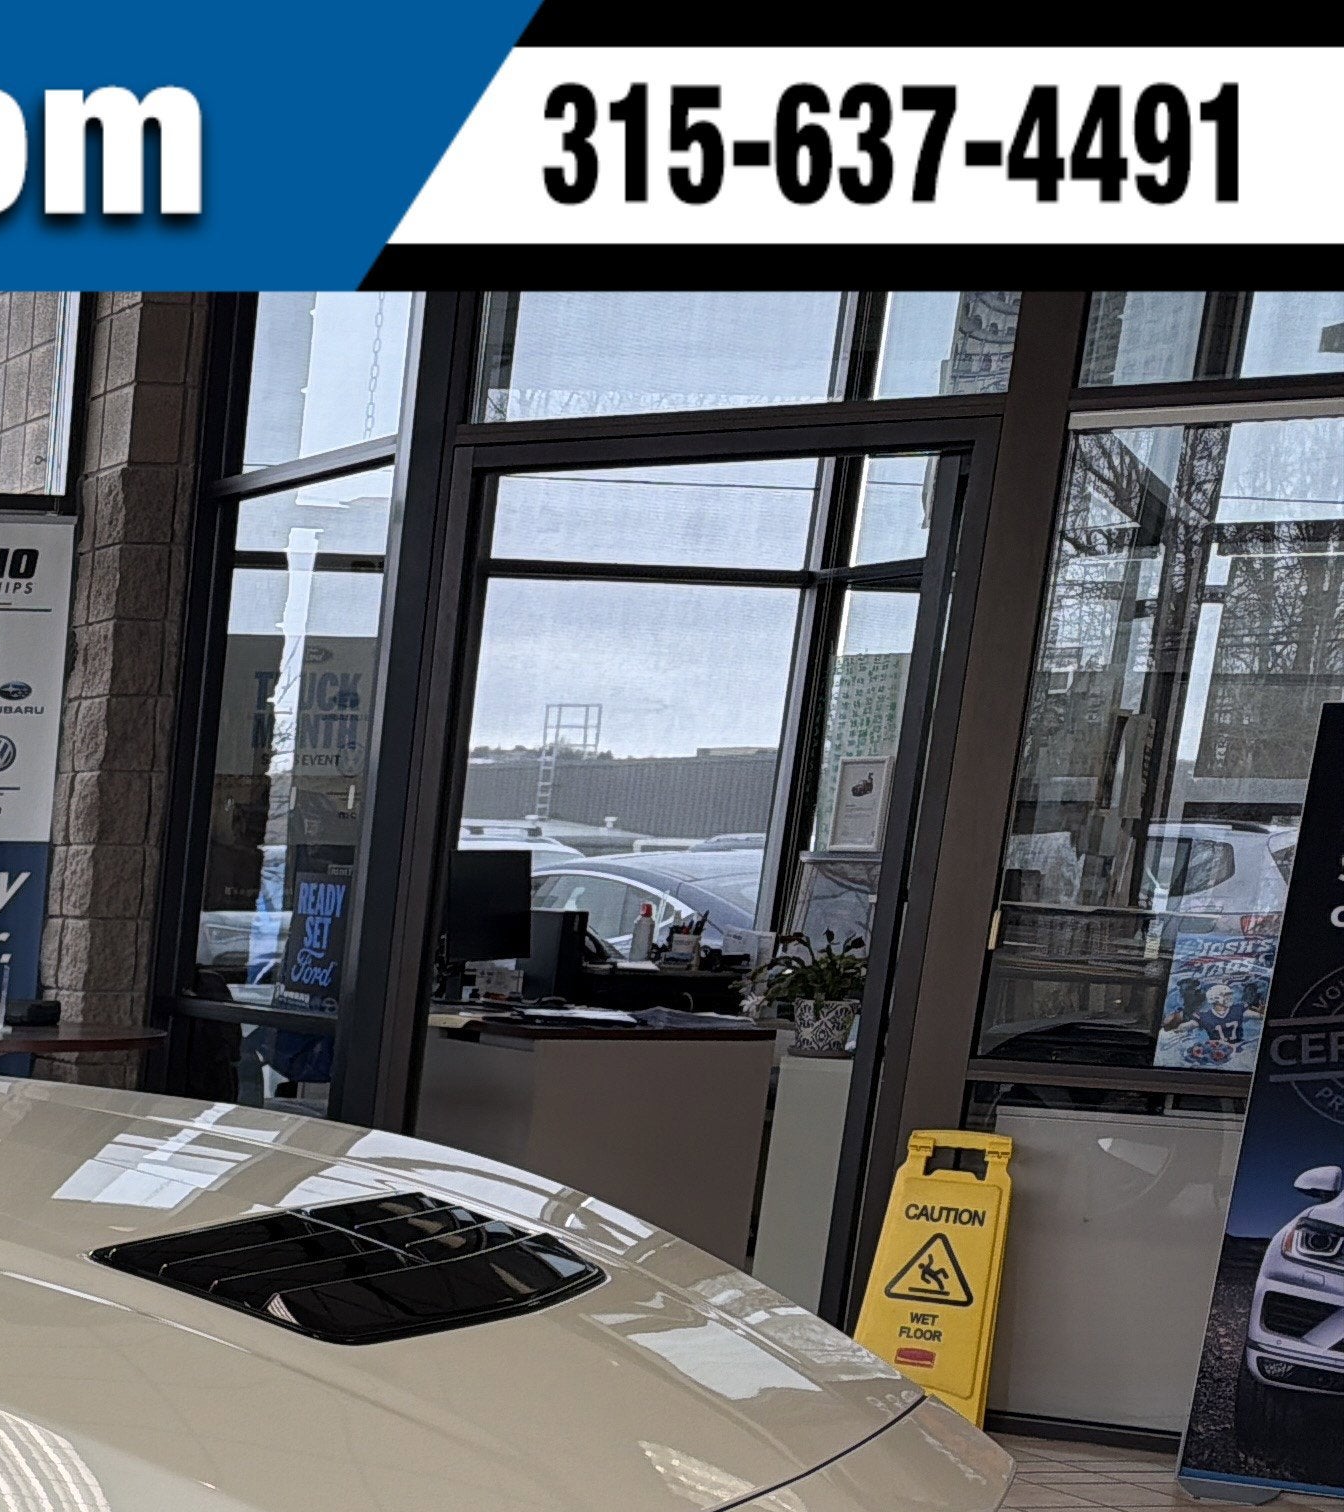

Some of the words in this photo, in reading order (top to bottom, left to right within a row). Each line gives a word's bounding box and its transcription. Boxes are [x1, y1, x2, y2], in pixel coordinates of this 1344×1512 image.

[252, 670, 364, 713] TUCK
[250, 712, 359, 750] MNTH
[302, 753, 342, 768] EVENT
[296, 880, 347, 920] READY
[303, 914, 332, 950] SET
[290, 947, 336, 990] Ford
[1312, 979, 1344, 1010] VO
[1215, 1018, 1239, 1042] 17
[904, 1202, 987, 1228] CAUTION
[898, 1325, 943, 1344] FLOOR
[909, 1312, 940, 1327] WET
